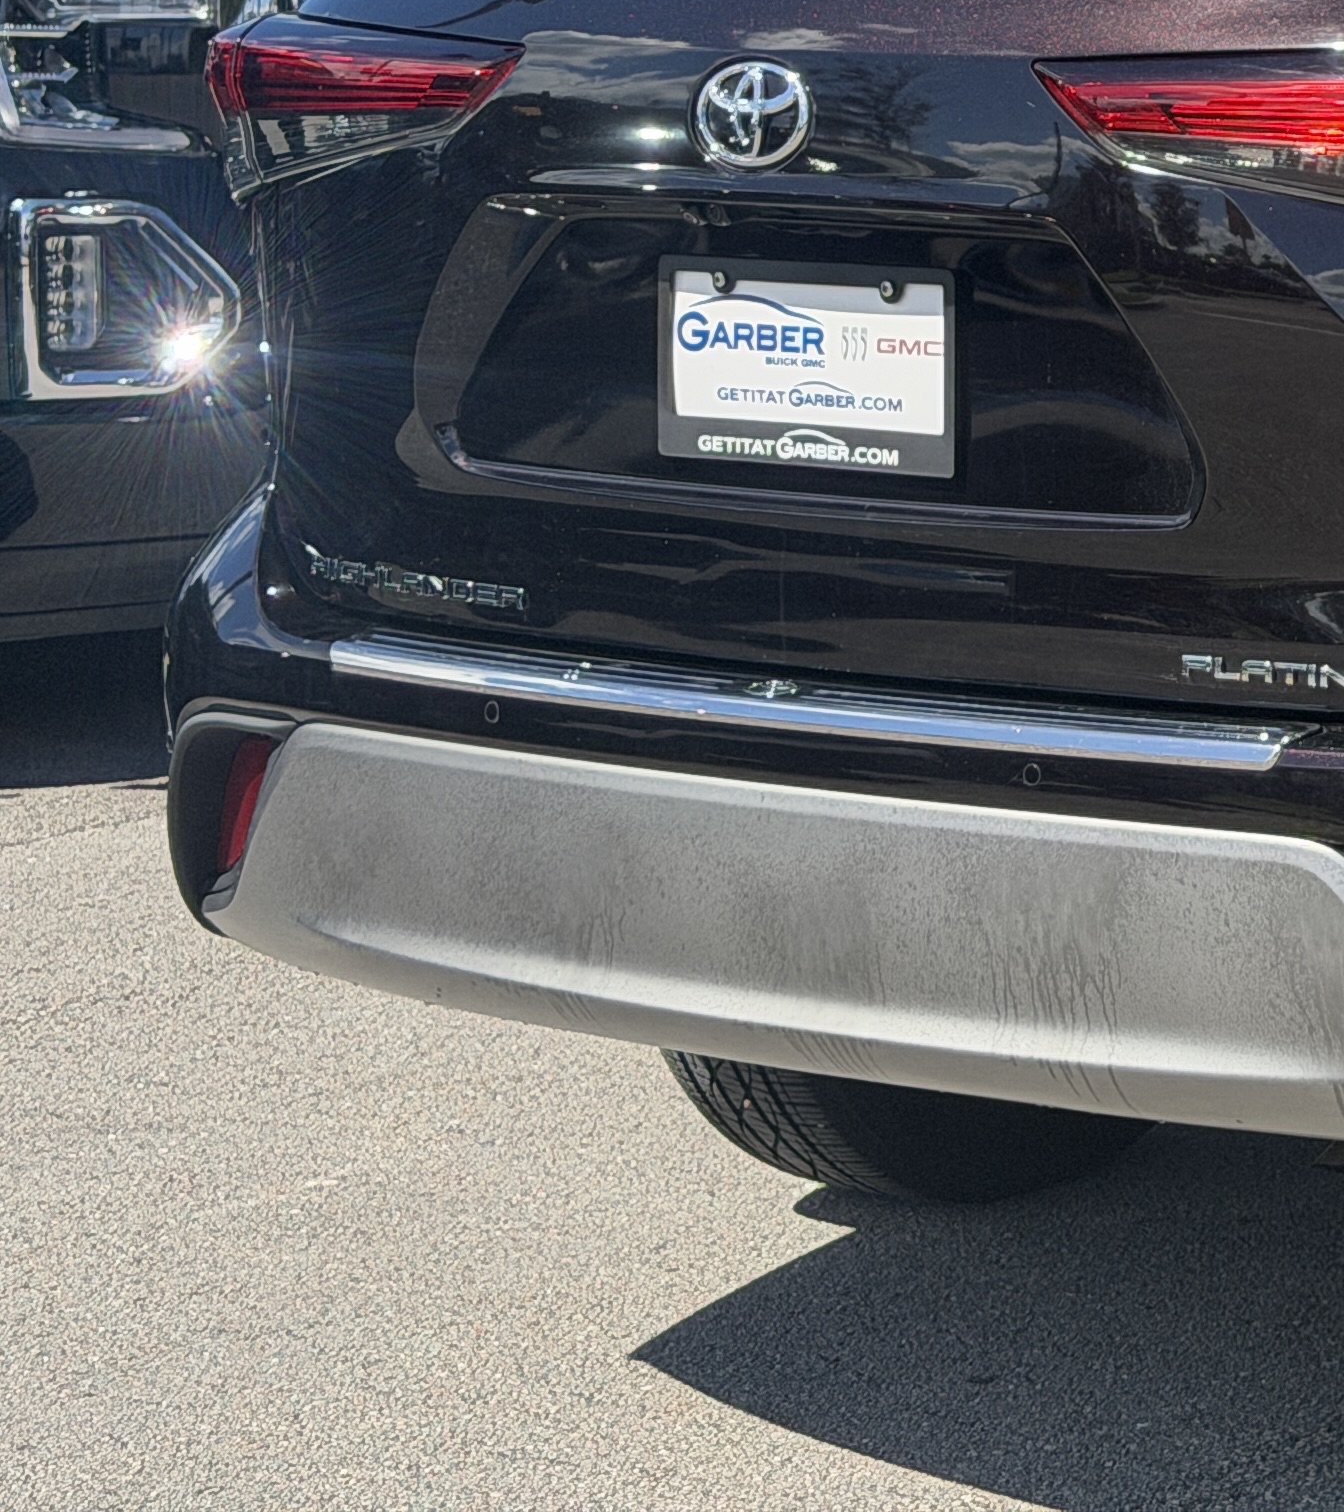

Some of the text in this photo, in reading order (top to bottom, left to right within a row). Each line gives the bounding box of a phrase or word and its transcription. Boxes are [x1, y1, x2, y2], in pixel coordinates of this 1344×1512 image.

[877, 338, 944, 356] GMC
[765, 356, 825, 368] BUICK GMC
